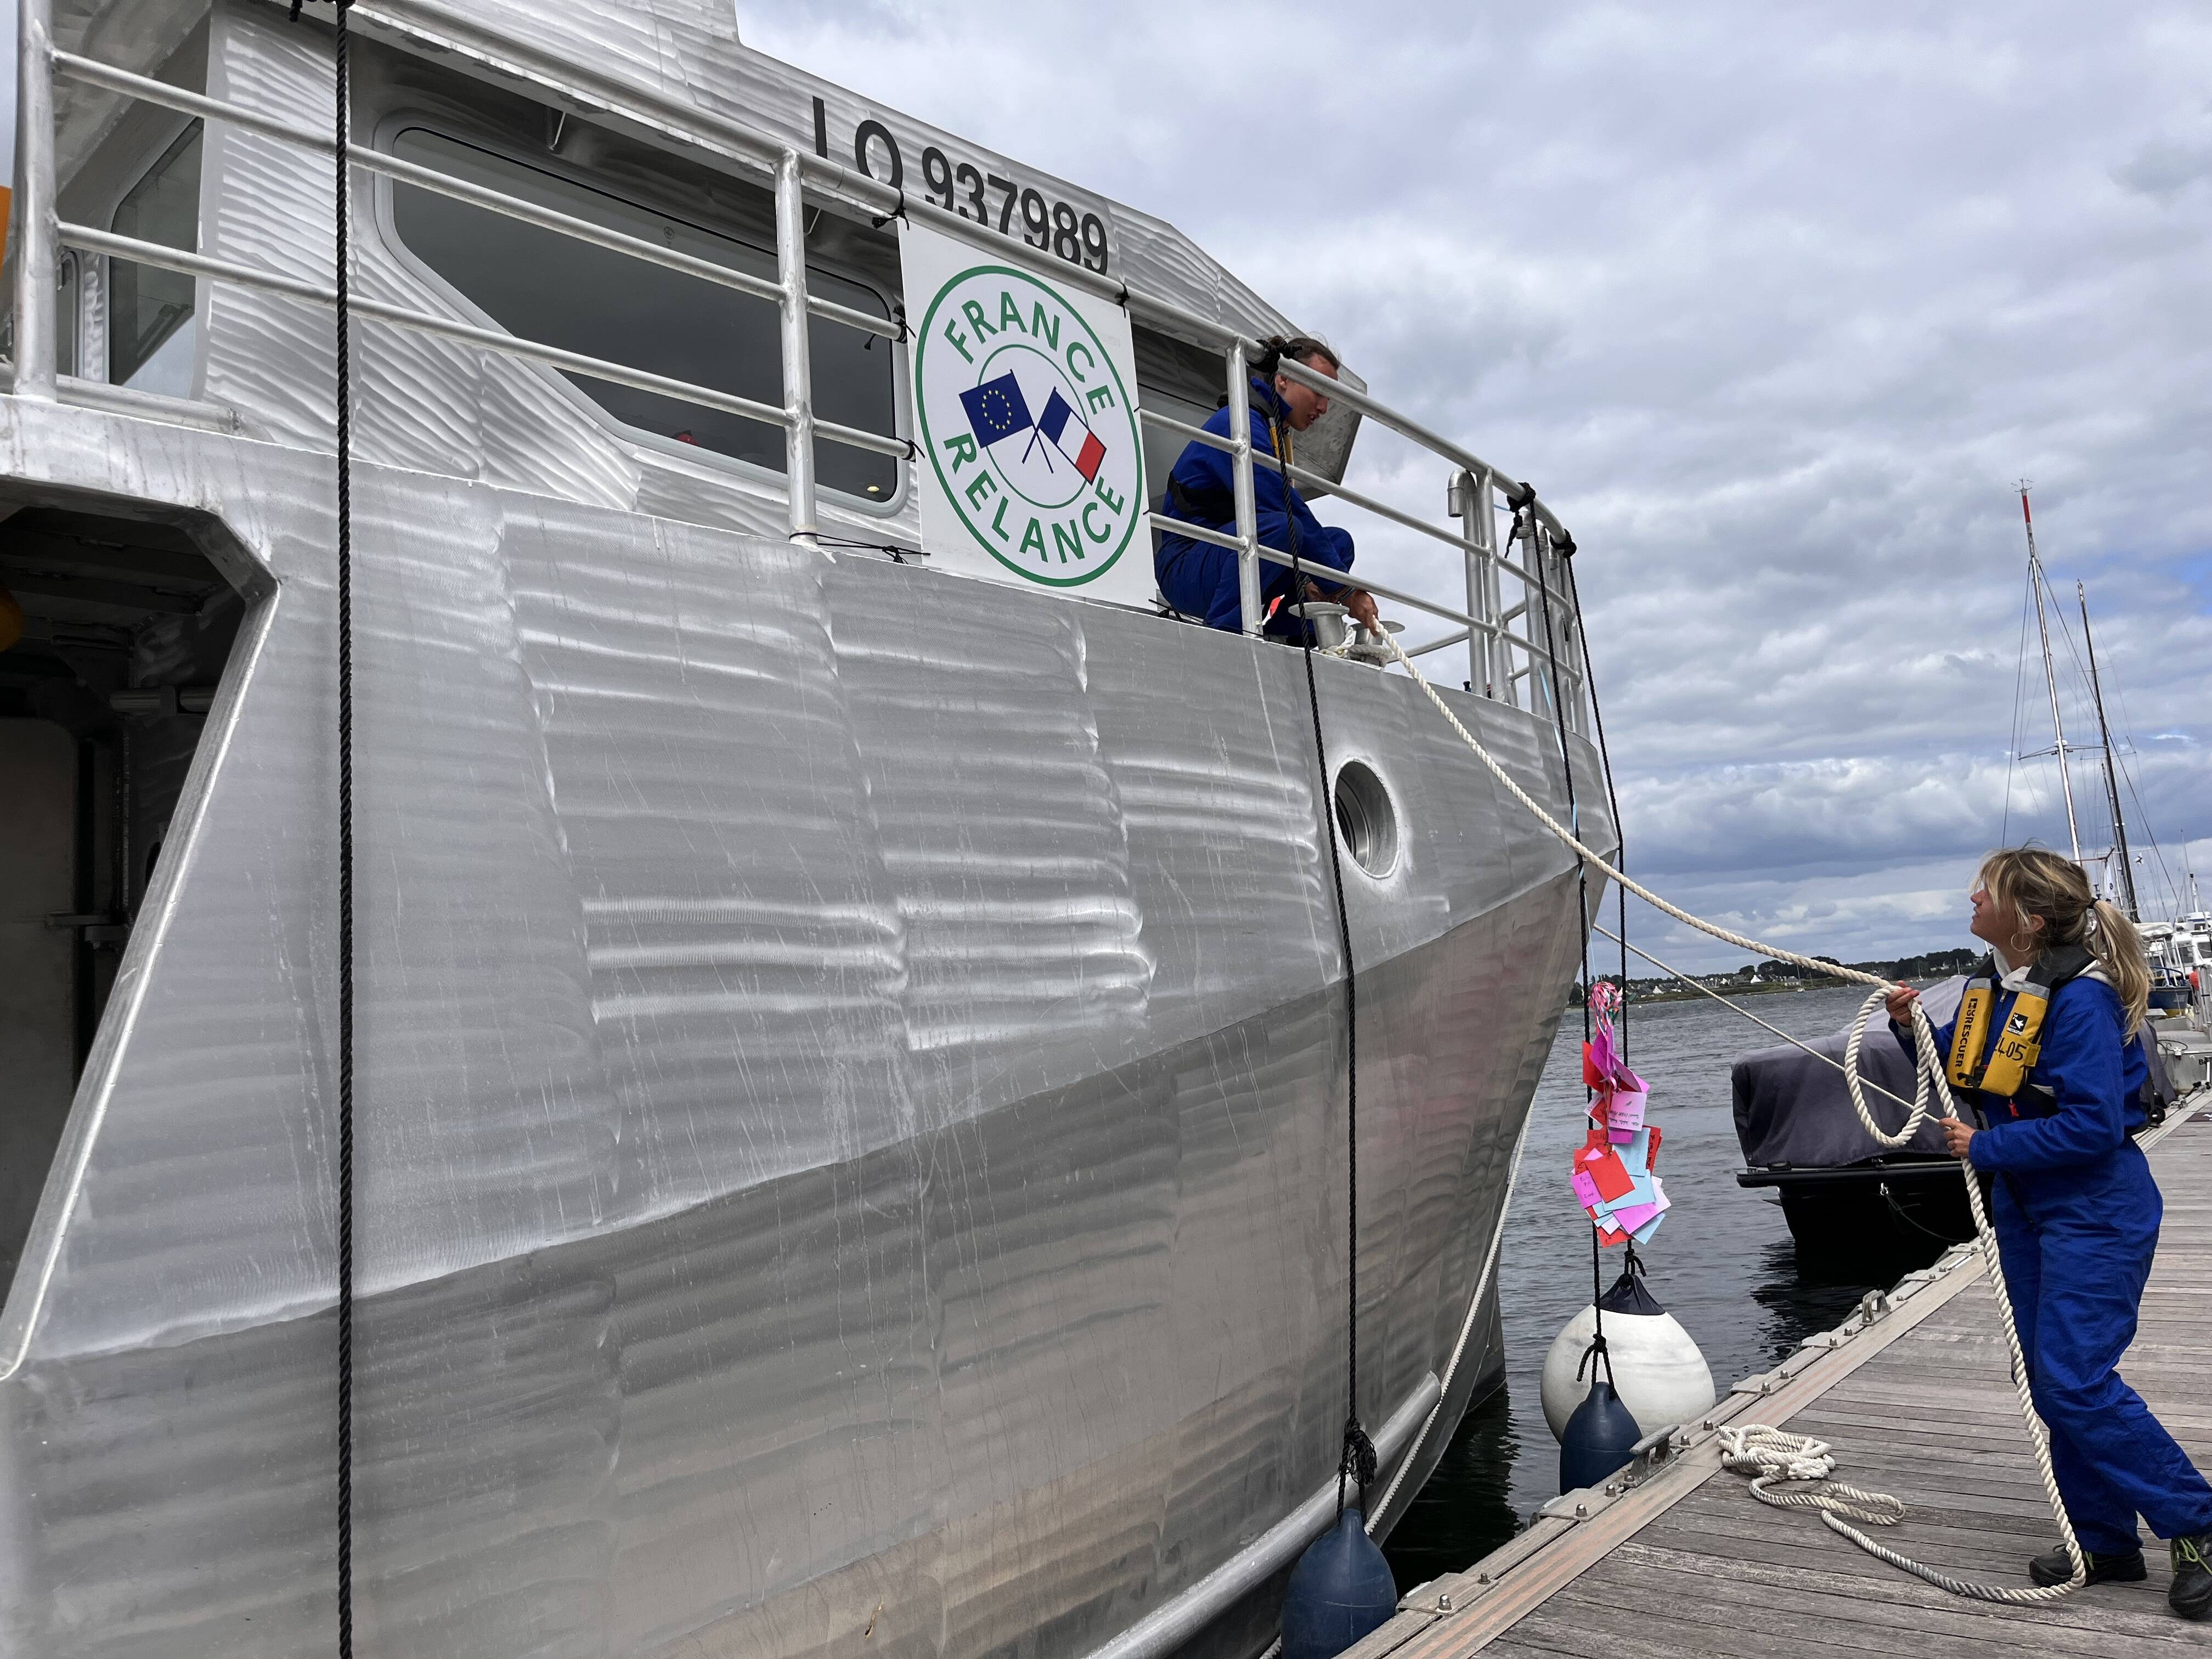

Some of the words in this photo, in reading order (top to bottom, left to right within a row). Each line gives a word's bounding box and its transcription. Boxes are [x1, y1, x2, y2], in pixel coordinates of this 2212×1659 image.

[922, 146, 1107, 276] 937989
[944, 292, 1115, 415] FRANCE
[944, 432, 1125, 564] RELANCE
